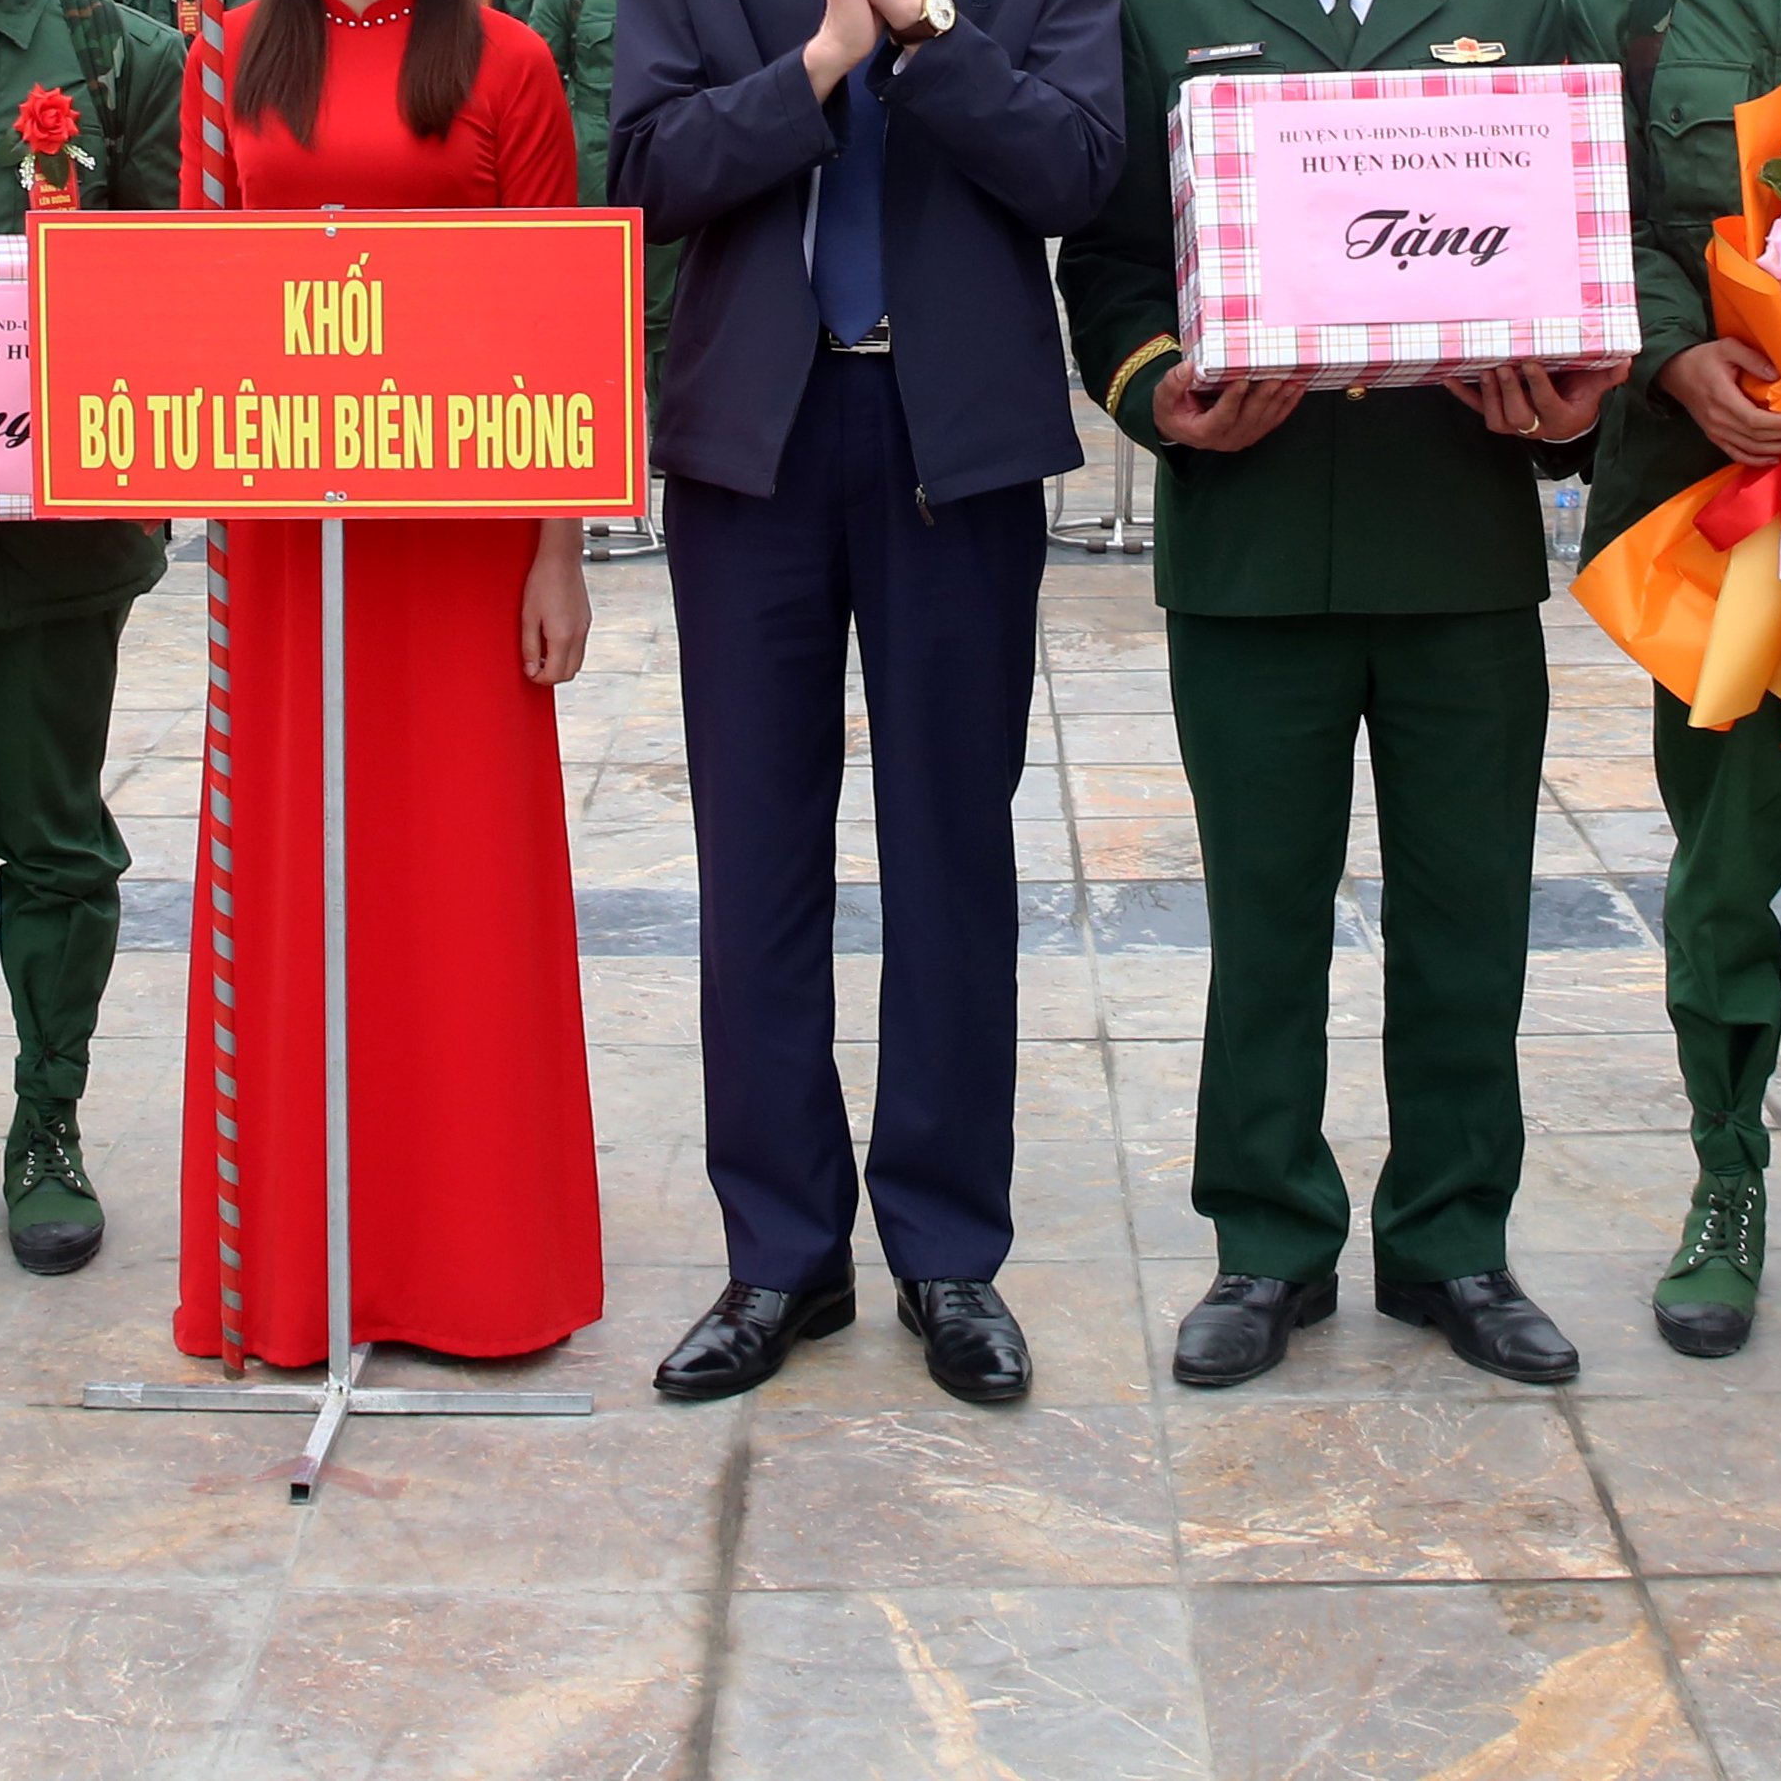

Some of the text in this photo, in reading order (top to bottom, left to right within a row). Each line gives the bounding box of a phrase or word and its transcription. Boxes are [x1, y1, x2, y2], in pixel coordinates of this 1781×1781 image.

[1279, 127, 1338, 145] HUYỆN
[1301, 146, 1531, 176] HUYỆN ĐOAN HÙNG
[1346, 209, 1510, 271] Tặng
[283, 253, 384, 356] KHỐI
[79, 375, 595, 487] BỘ TƯ LỆNH BIÊN PHÒNG
